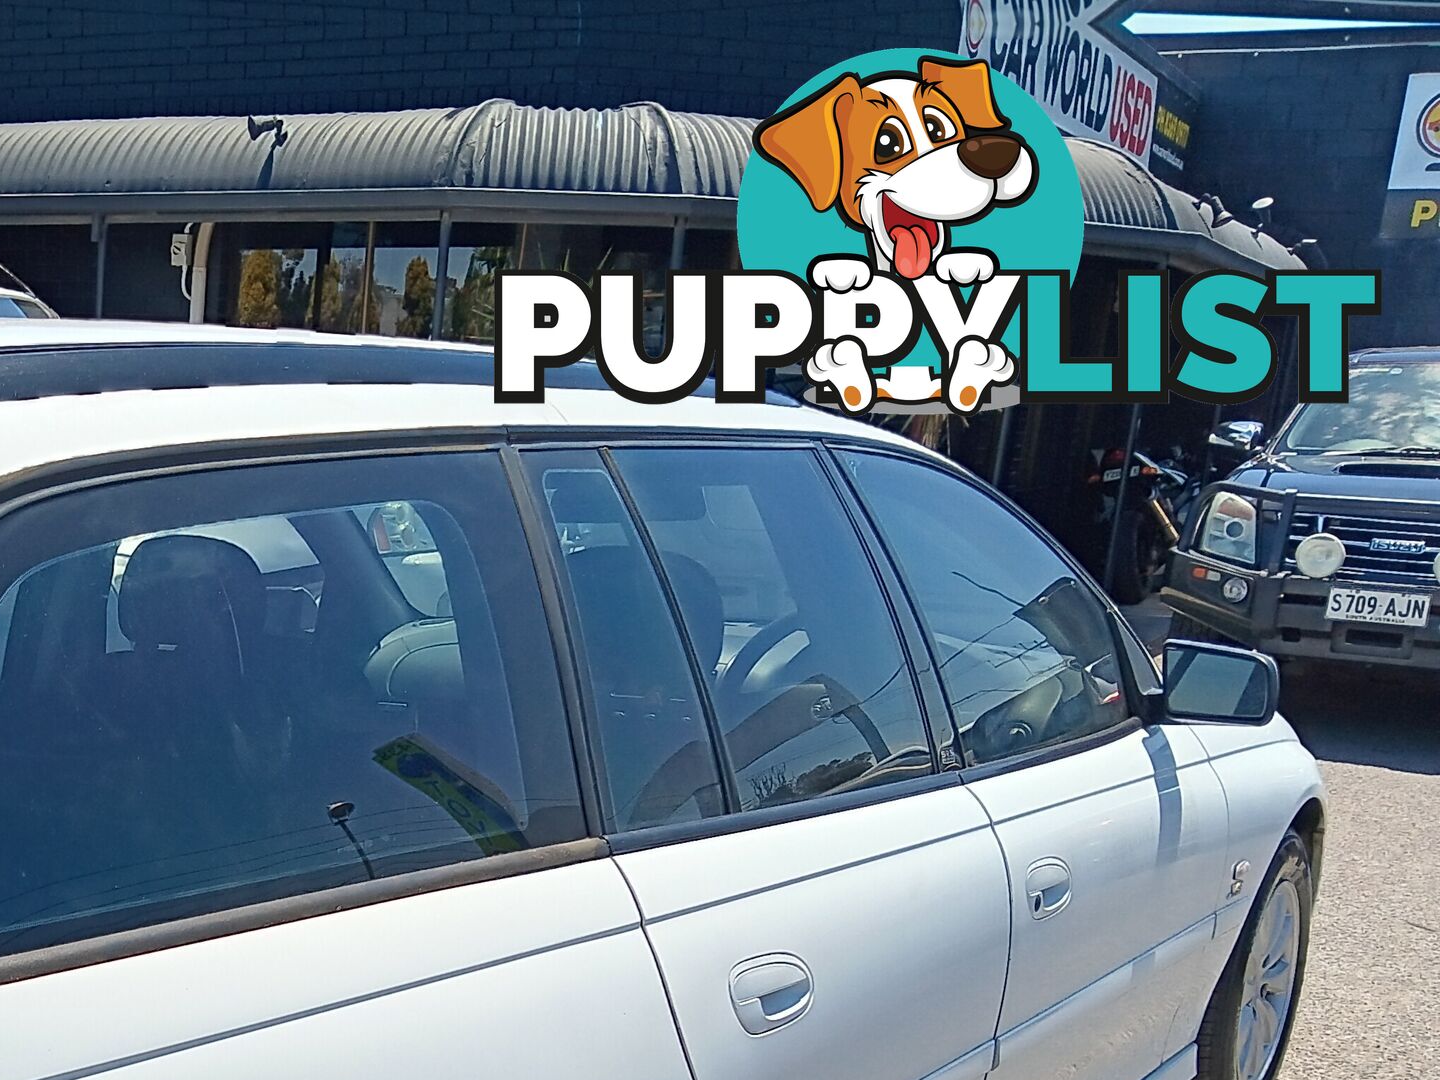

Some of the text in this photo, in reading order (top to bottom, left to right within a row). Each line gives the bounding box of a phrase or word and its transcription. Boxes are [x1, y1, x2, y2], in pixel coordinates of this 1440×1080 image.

[990, 22, 1040, 97] CAR
[1043, 25, 1113, 133] WORLD
[1109, 65, 1153, 158] USED
